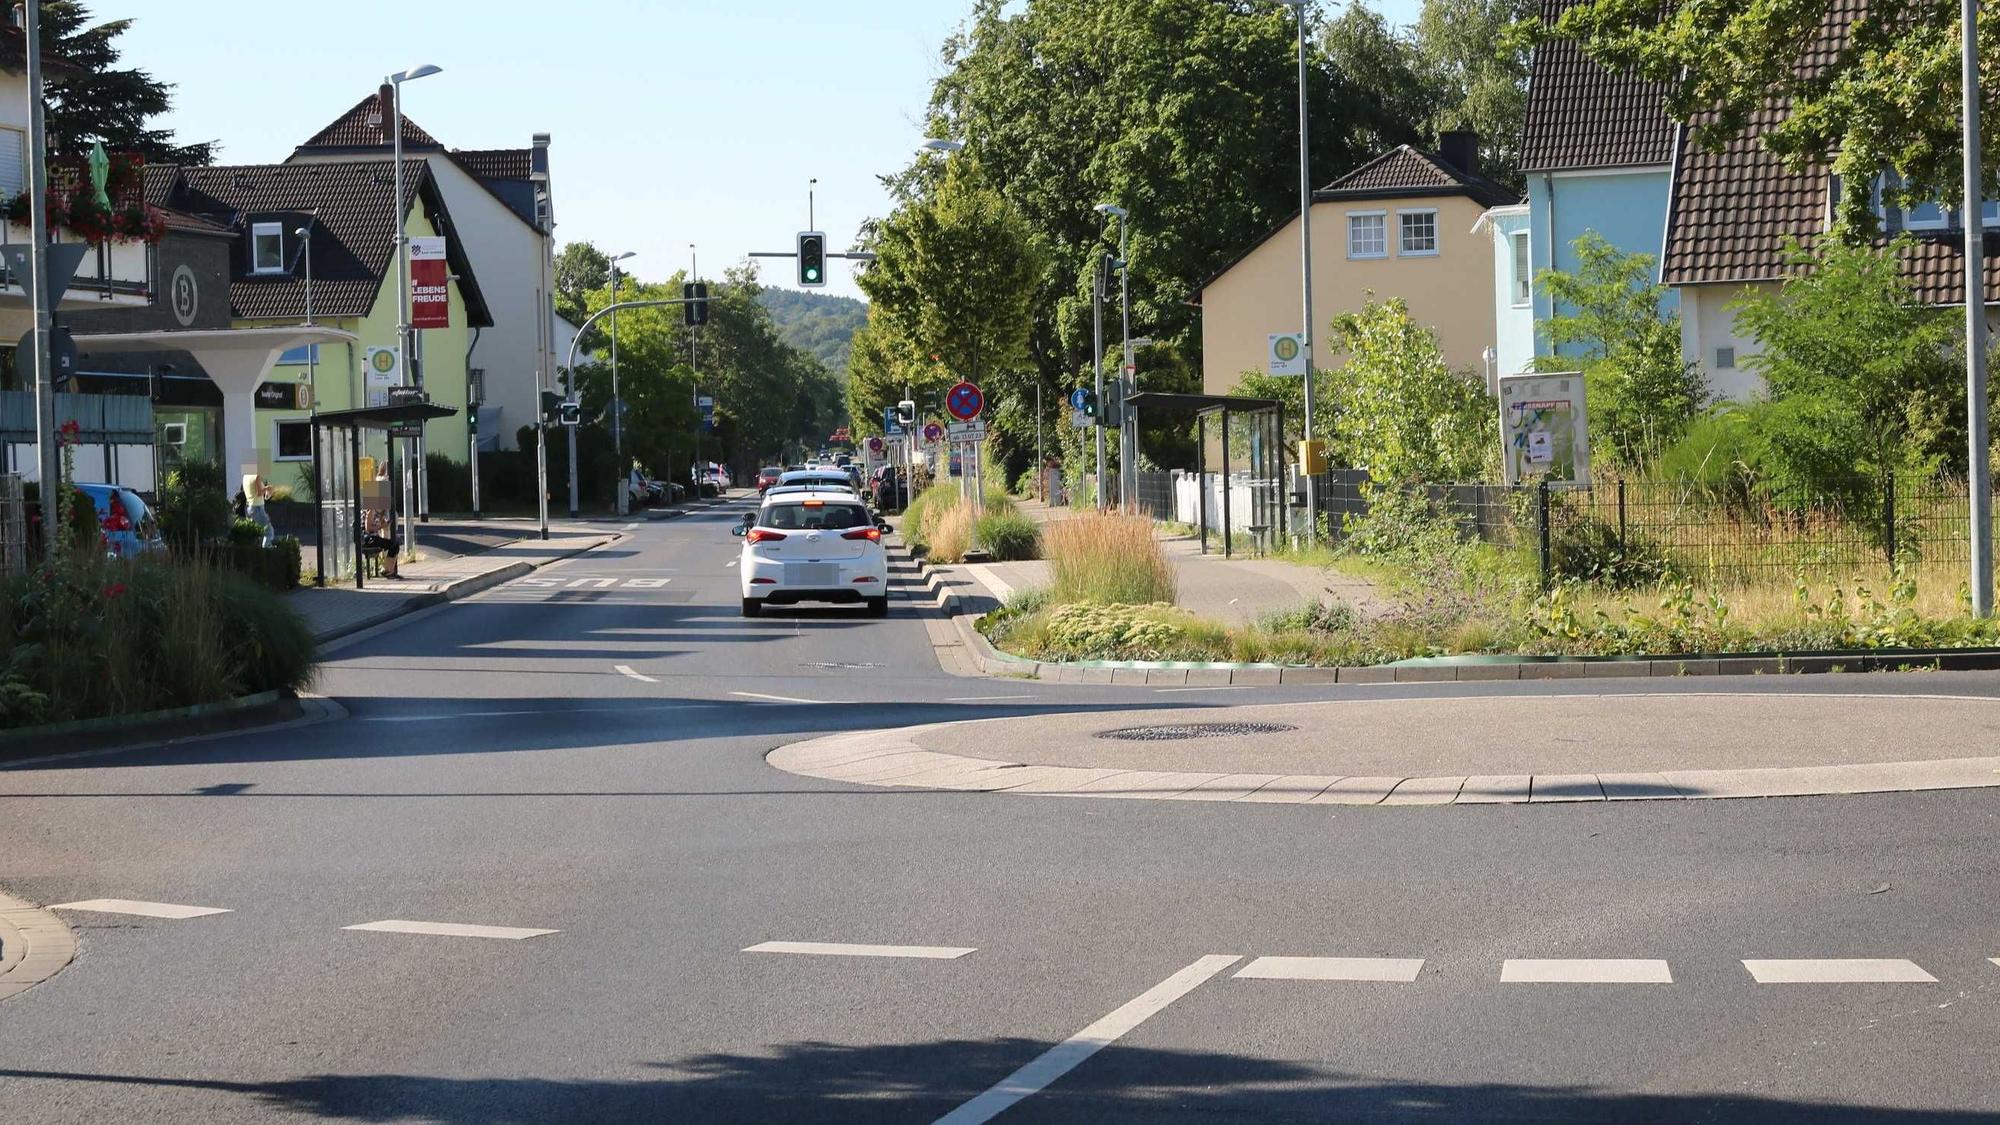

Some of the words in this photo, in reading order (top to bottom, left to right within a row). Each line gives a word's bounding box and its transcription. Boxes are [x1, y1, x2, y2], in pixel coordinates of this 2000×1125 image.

[412, 285, 447, 294] LEBENS
[412, 294, 447, 303] FREUDE
[511, 578, 672, 588] BUS
